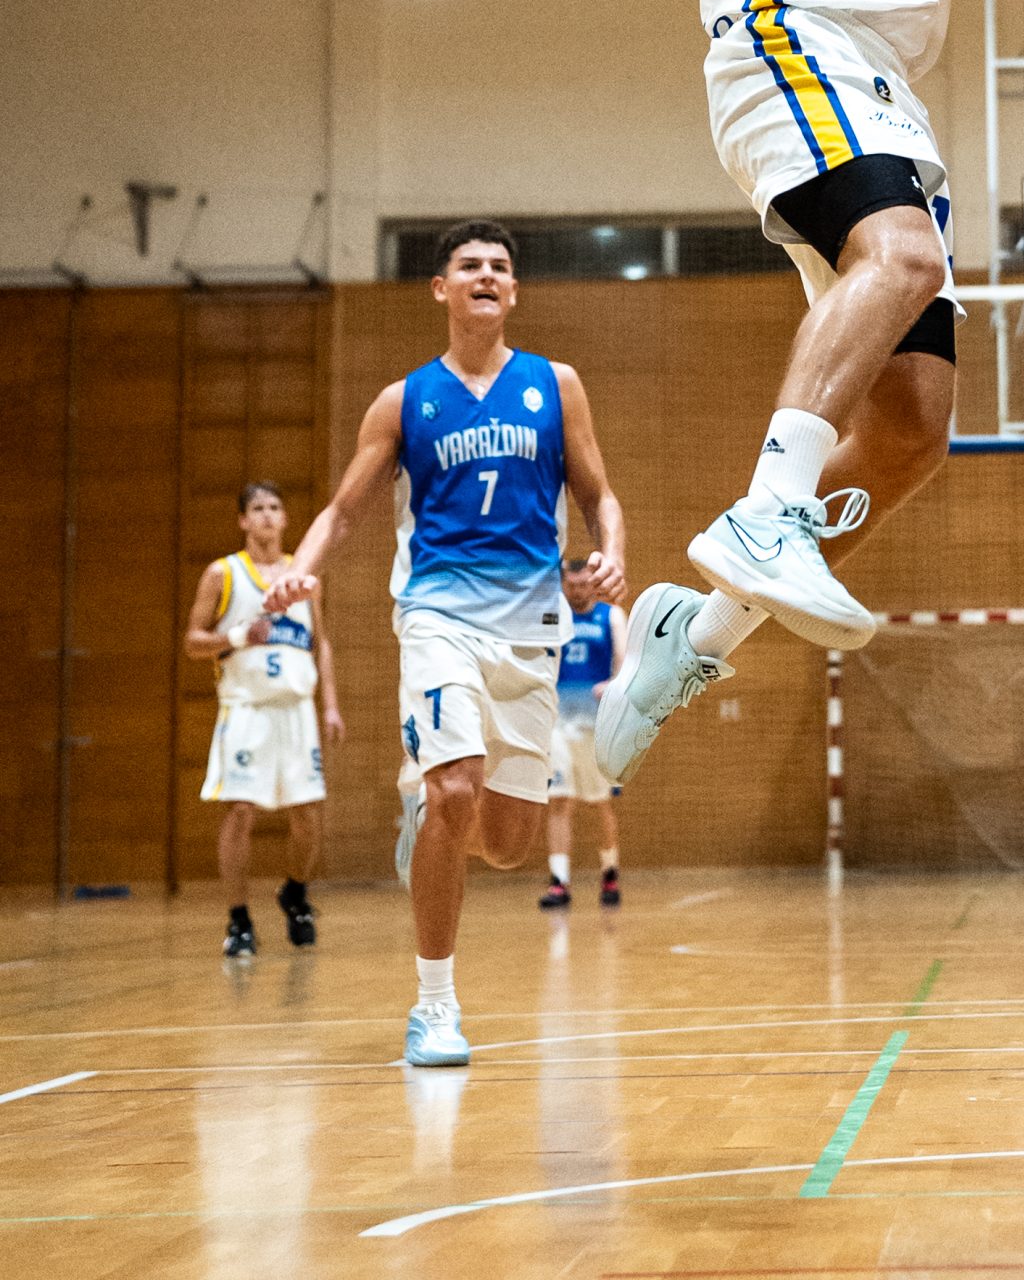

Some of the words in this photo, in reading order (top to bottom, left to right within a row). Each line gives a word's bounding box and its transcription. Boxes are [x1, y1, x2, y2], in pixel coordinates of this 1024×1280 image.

[434, 417, 538, 471] VARAŽDIN
[478, 469, 499, 516] 7
[267, 653, 281, 678] 5
